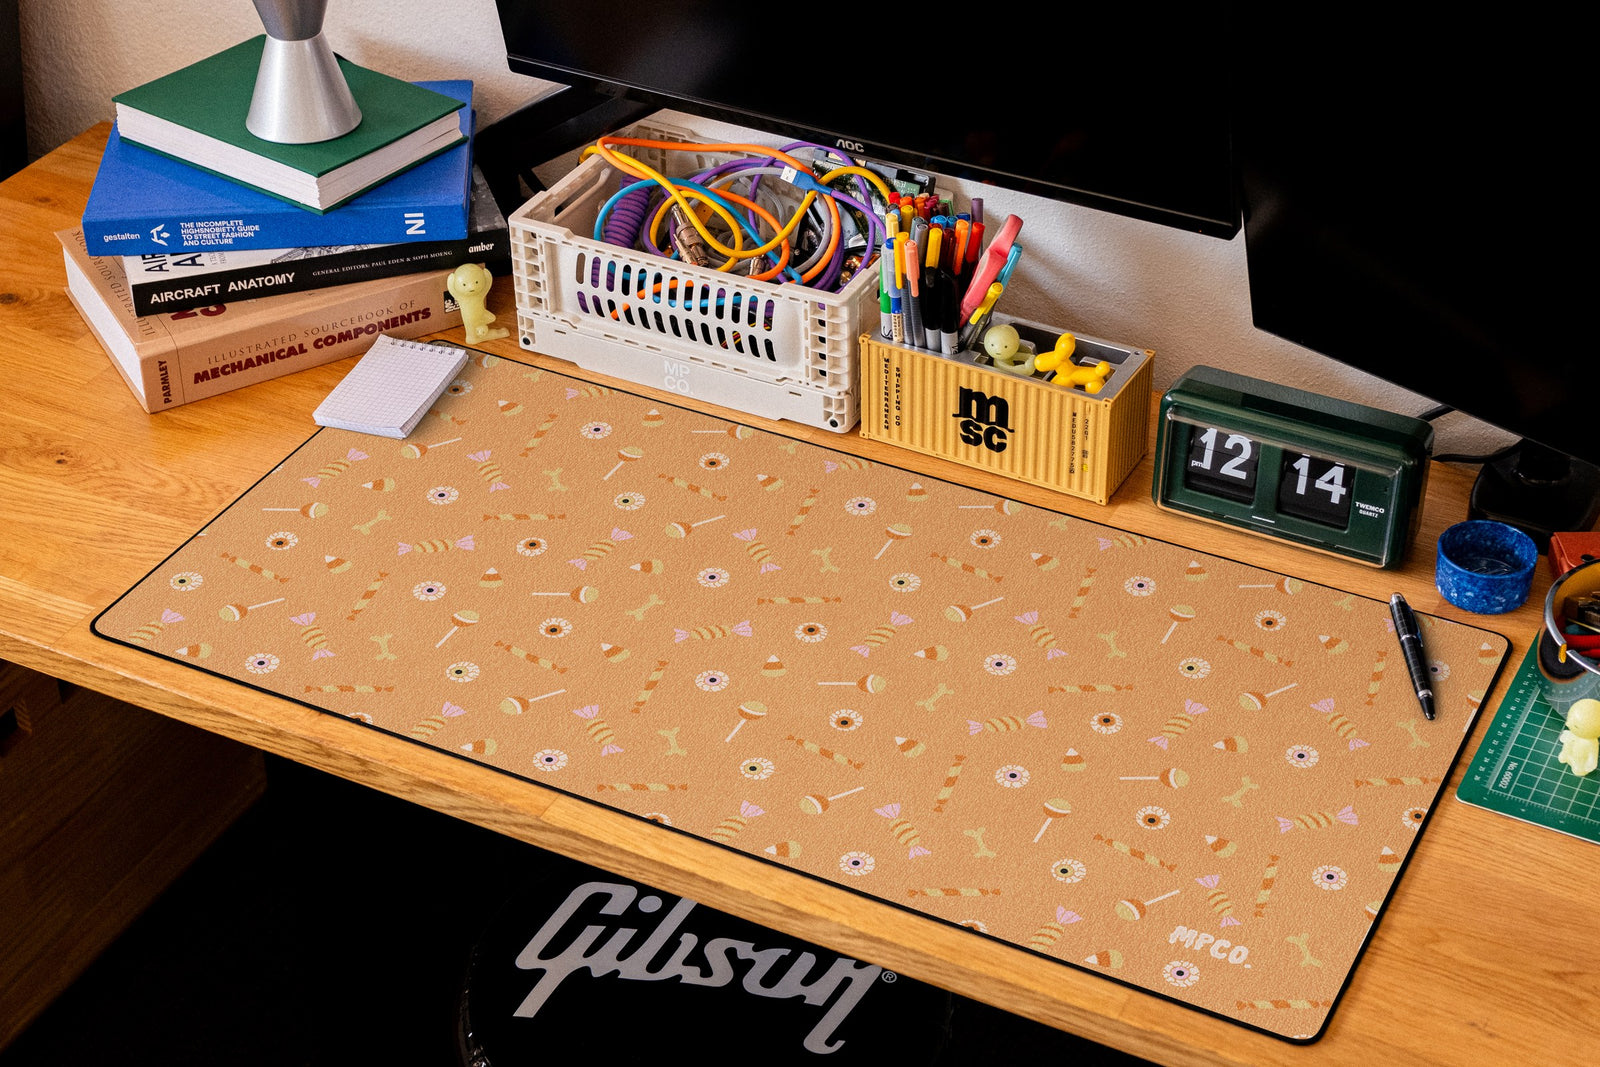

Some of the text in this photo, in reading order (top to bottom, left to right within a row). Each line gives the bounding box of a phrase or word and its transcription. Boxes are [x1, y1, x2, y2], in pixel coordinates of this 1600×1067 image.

[836, 139, 865, 153] AOC
[181, 226, 235, 234] HIGHSNOBIETY
[196, 220, 243, 228] INCOMPLETE
[103, 232, 140, 243] gestalten
[468, 242, 495, 254] amber
[312, 267, 341, 276] GENERAL
[342, 263, 370, 272] EDITORS:
[150, 272, 295, 304] AIRCRAFT ANATOMY
[207, 333, 297, 365] ILLUSTRATED
[303, 308, 393, 337] SOURCEBOOK
[399, 300, 416, 312] OF
[193, 307, 432, 384] MECHANICAL COMPONENTS
[158, 360, 172, 404] PARMLEY
[1200, 427, 1252, 480] 12
[1292, 457, 1346, 504] 14
[1355, 501, 1385, 514] TWEMCO
[1498, 770, 1513, 789] 60002
[513, 881, 883, 1055] Gibson
